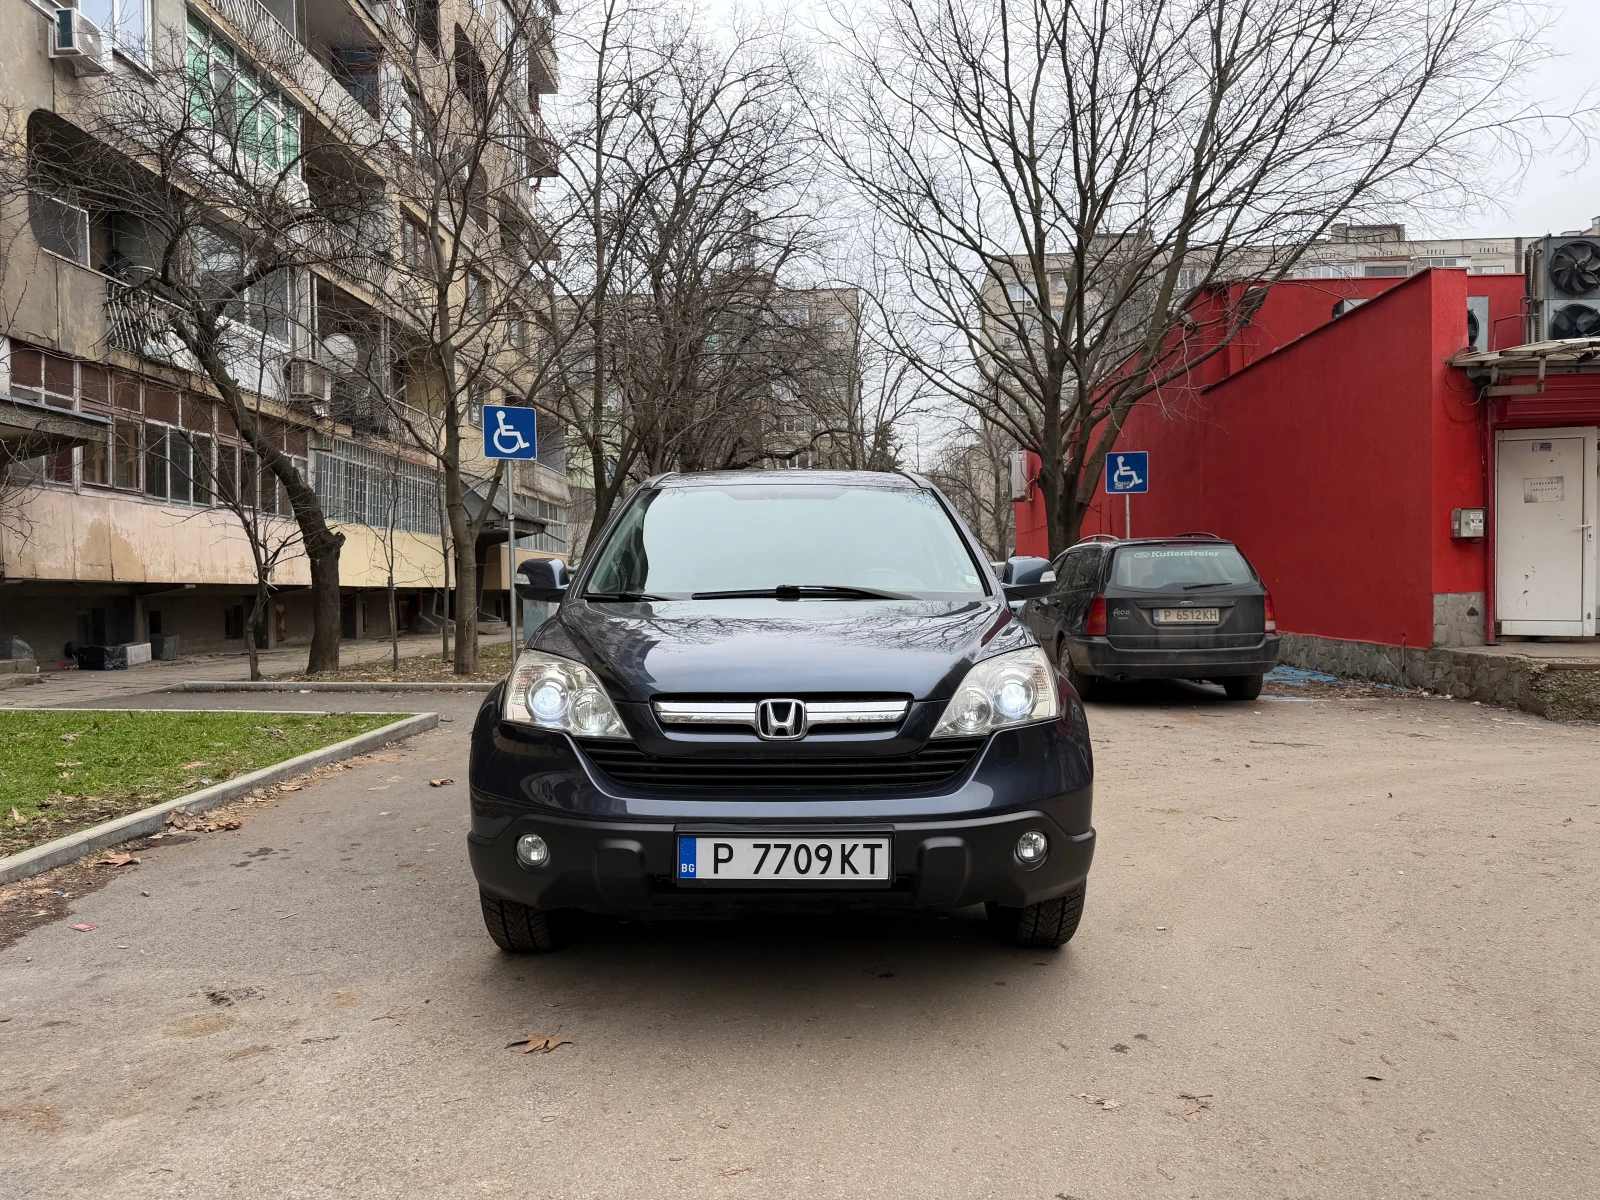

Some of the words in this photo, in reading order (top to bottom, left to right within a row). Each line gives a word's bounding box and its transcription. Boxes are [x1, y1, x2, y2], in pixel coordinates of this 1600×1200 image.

[1151, 550, 1220, 558] Kuttendreier
[713, 843, 734, 875] P
[681, 864, 695, 873] BG
